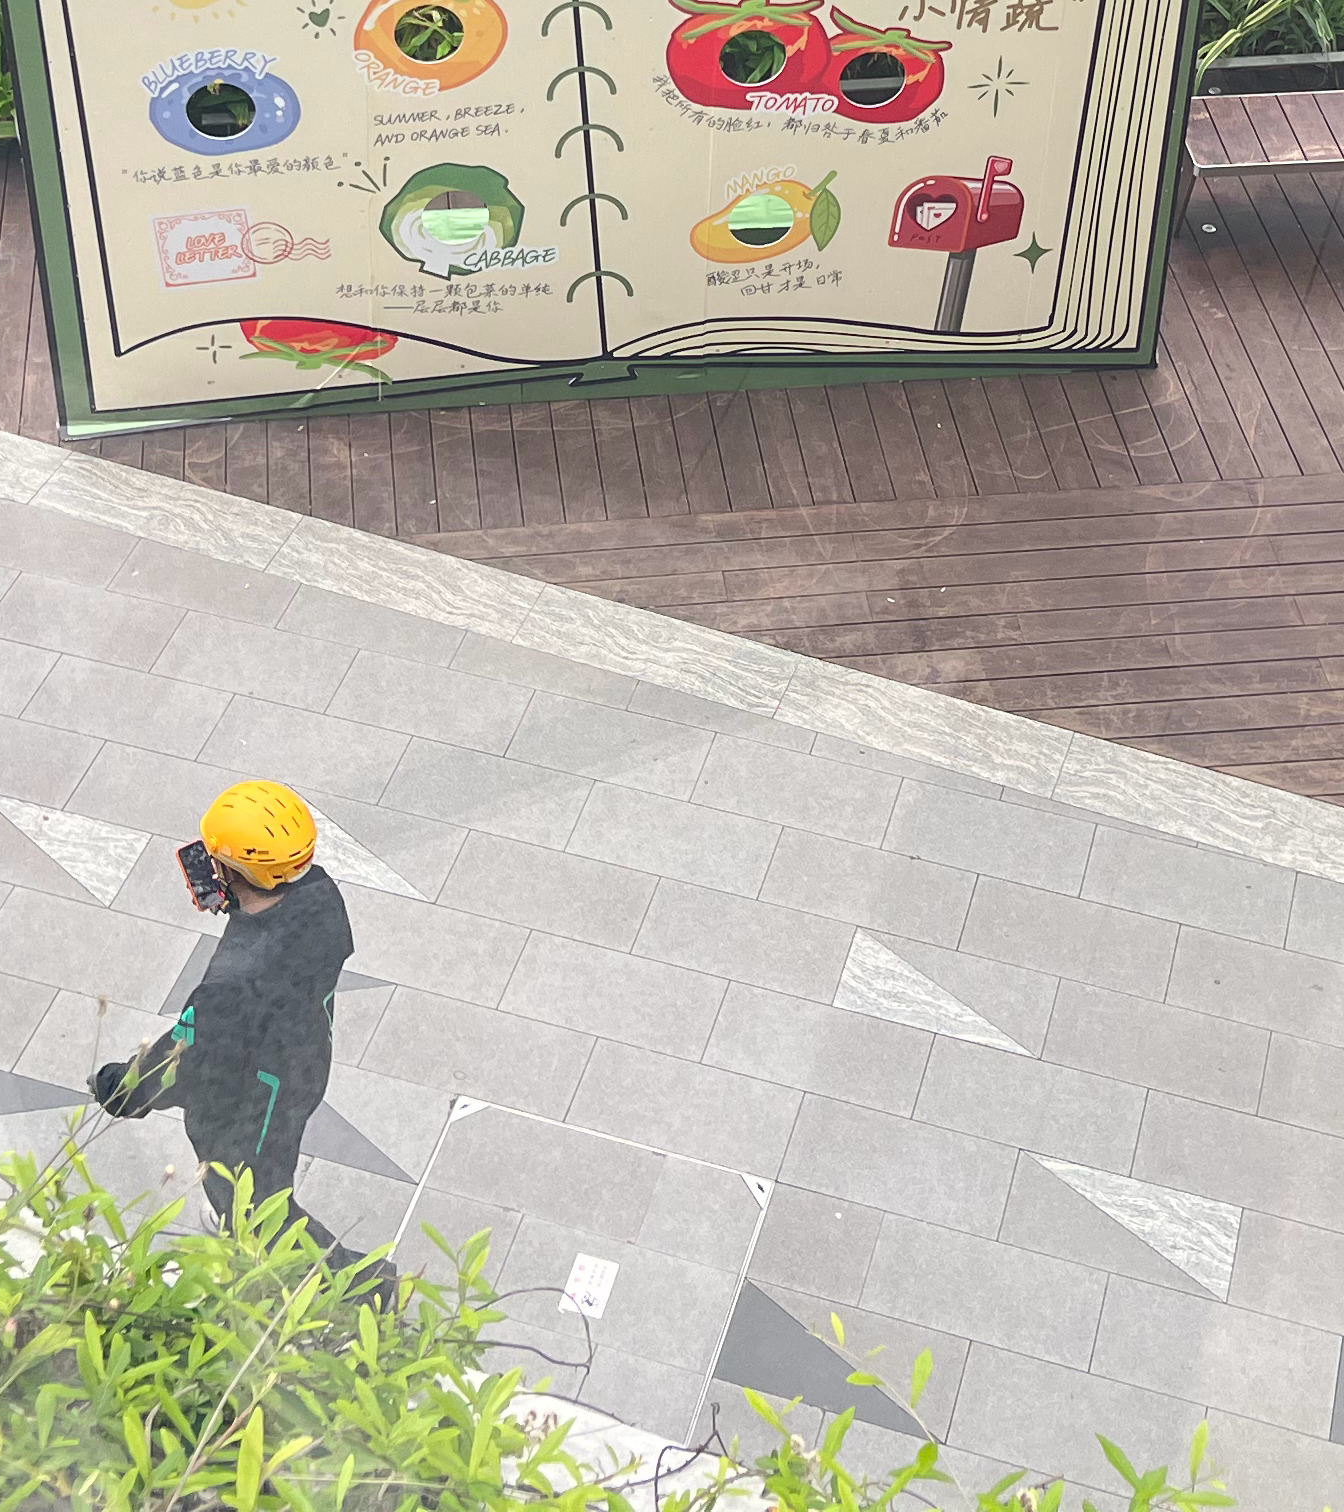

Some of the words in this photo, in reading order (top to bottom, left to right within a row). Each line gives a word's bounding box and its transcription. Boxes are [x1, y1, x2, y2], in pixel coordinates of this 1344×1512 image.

[141, 48, 277, 95] BLUEBERRY
[355, 51, 440, 96] ORANGE
[751, 93, 837, 116] TOMATO
[373, 133, 405, 147] AND
[411, 126, 470, 142] ORANGE
[726, 165, 796, 200] MANGO
[186, 232, 226, 250] LOVE
[175, 245, 243, 265] LETTER
[463, 247, 556, 269] CABBAGE
